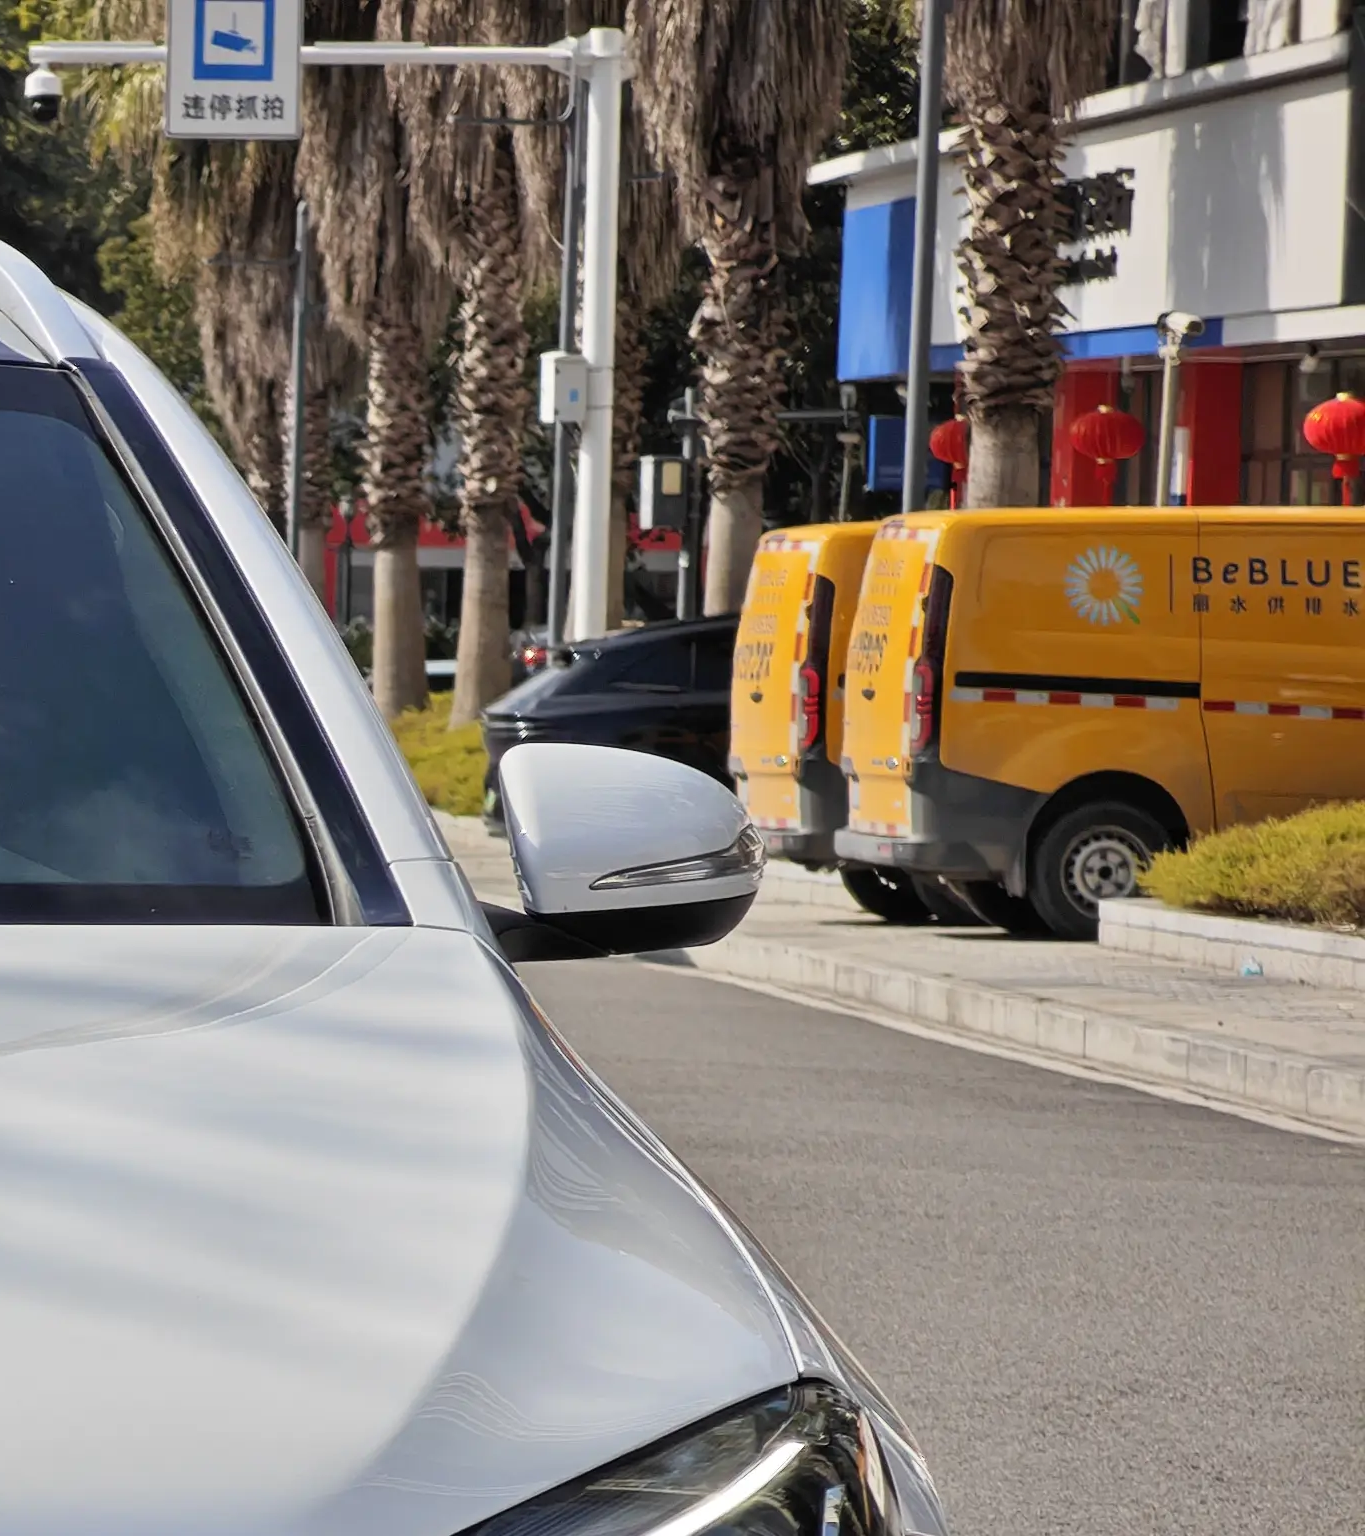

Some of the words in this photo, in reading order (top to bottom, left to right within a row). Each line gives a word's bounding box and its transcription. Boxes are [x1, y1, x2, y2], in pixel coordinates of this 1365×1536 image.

[182, 93, 285, 121] 违停抓拍
[1192, 556, 1362, 588] BeBLUE
